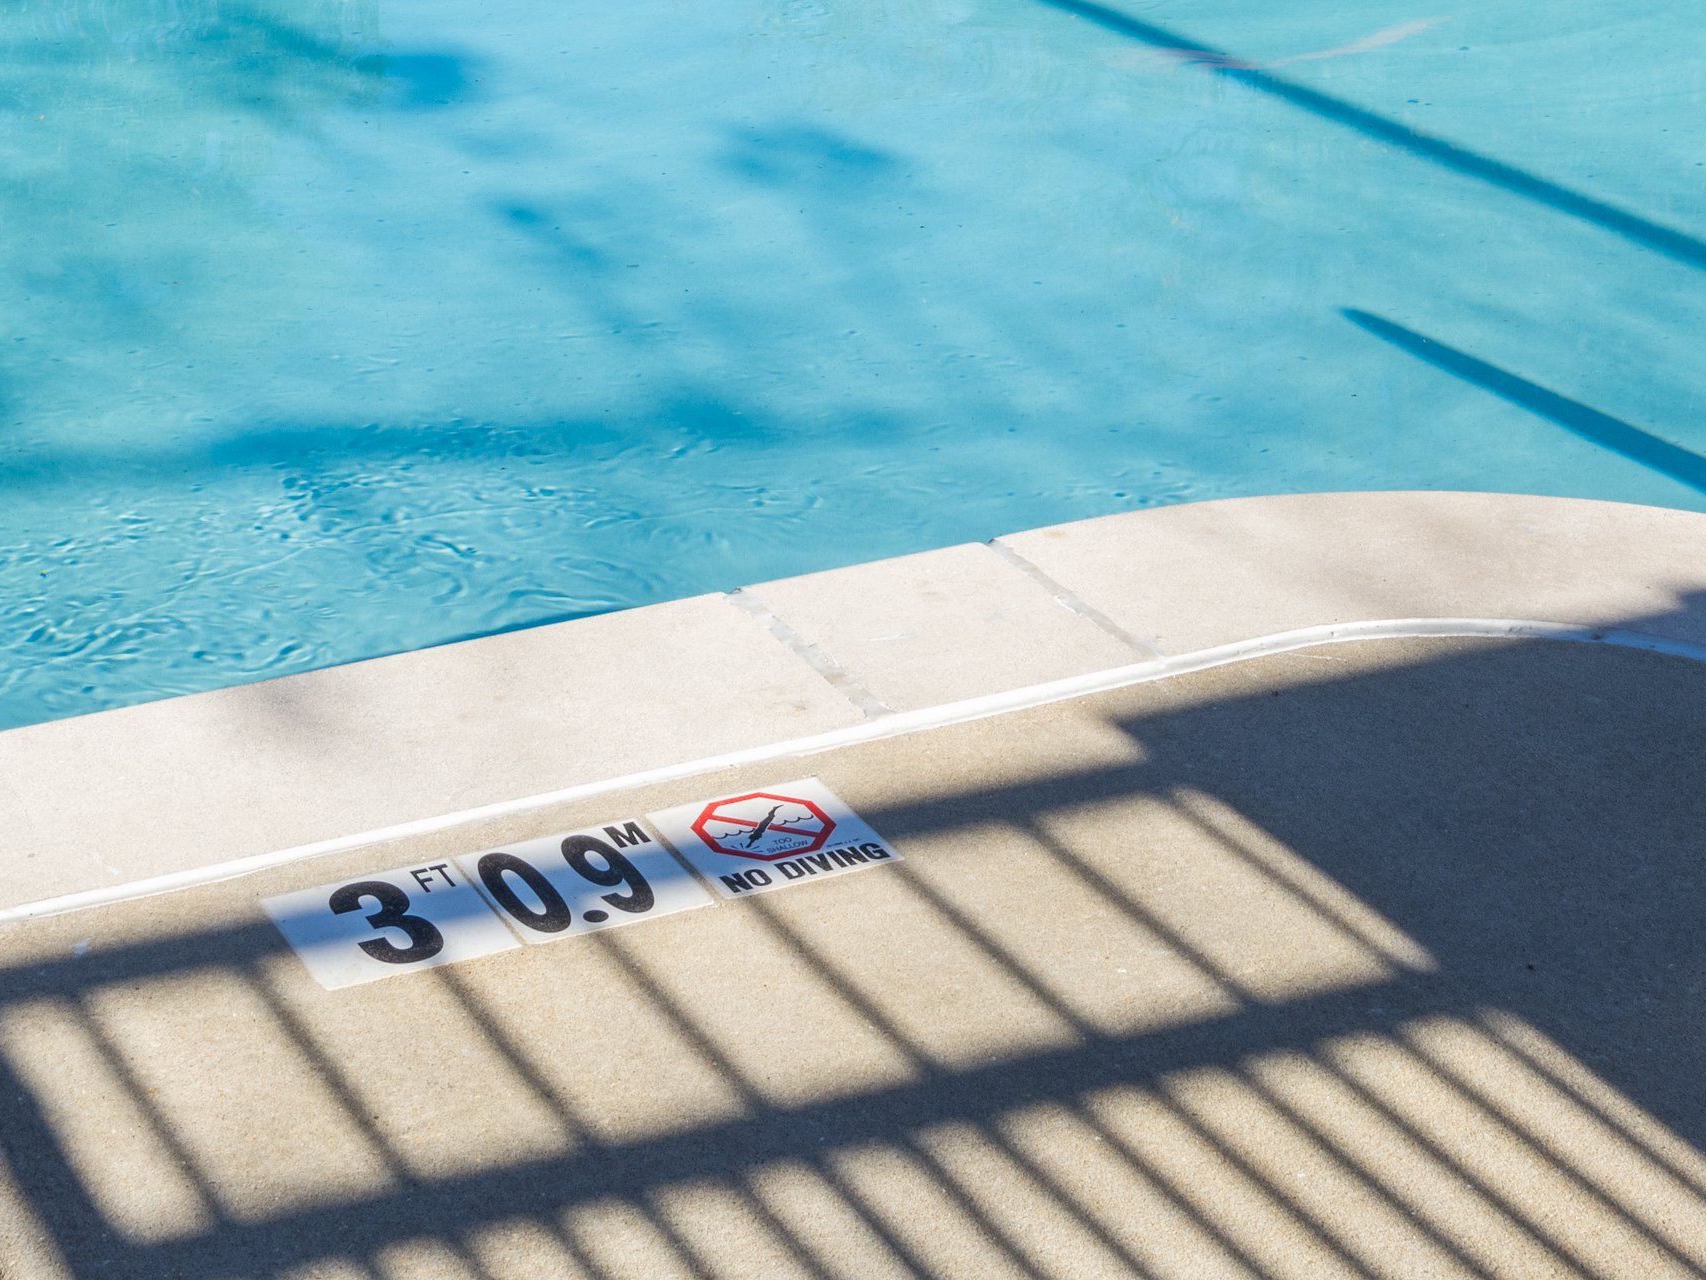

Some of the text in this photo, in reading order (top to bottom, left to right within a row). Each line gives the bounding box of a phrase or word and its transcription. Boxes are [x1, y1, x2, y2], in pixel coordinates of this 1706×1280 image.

[766, 840, 809, 854] SHALLOW
[773, 836, 793, 846] TOO
[718, 842, 891, 894] NO DIVING
[328, 821, 656, 964] 3 FT 0.9 M
